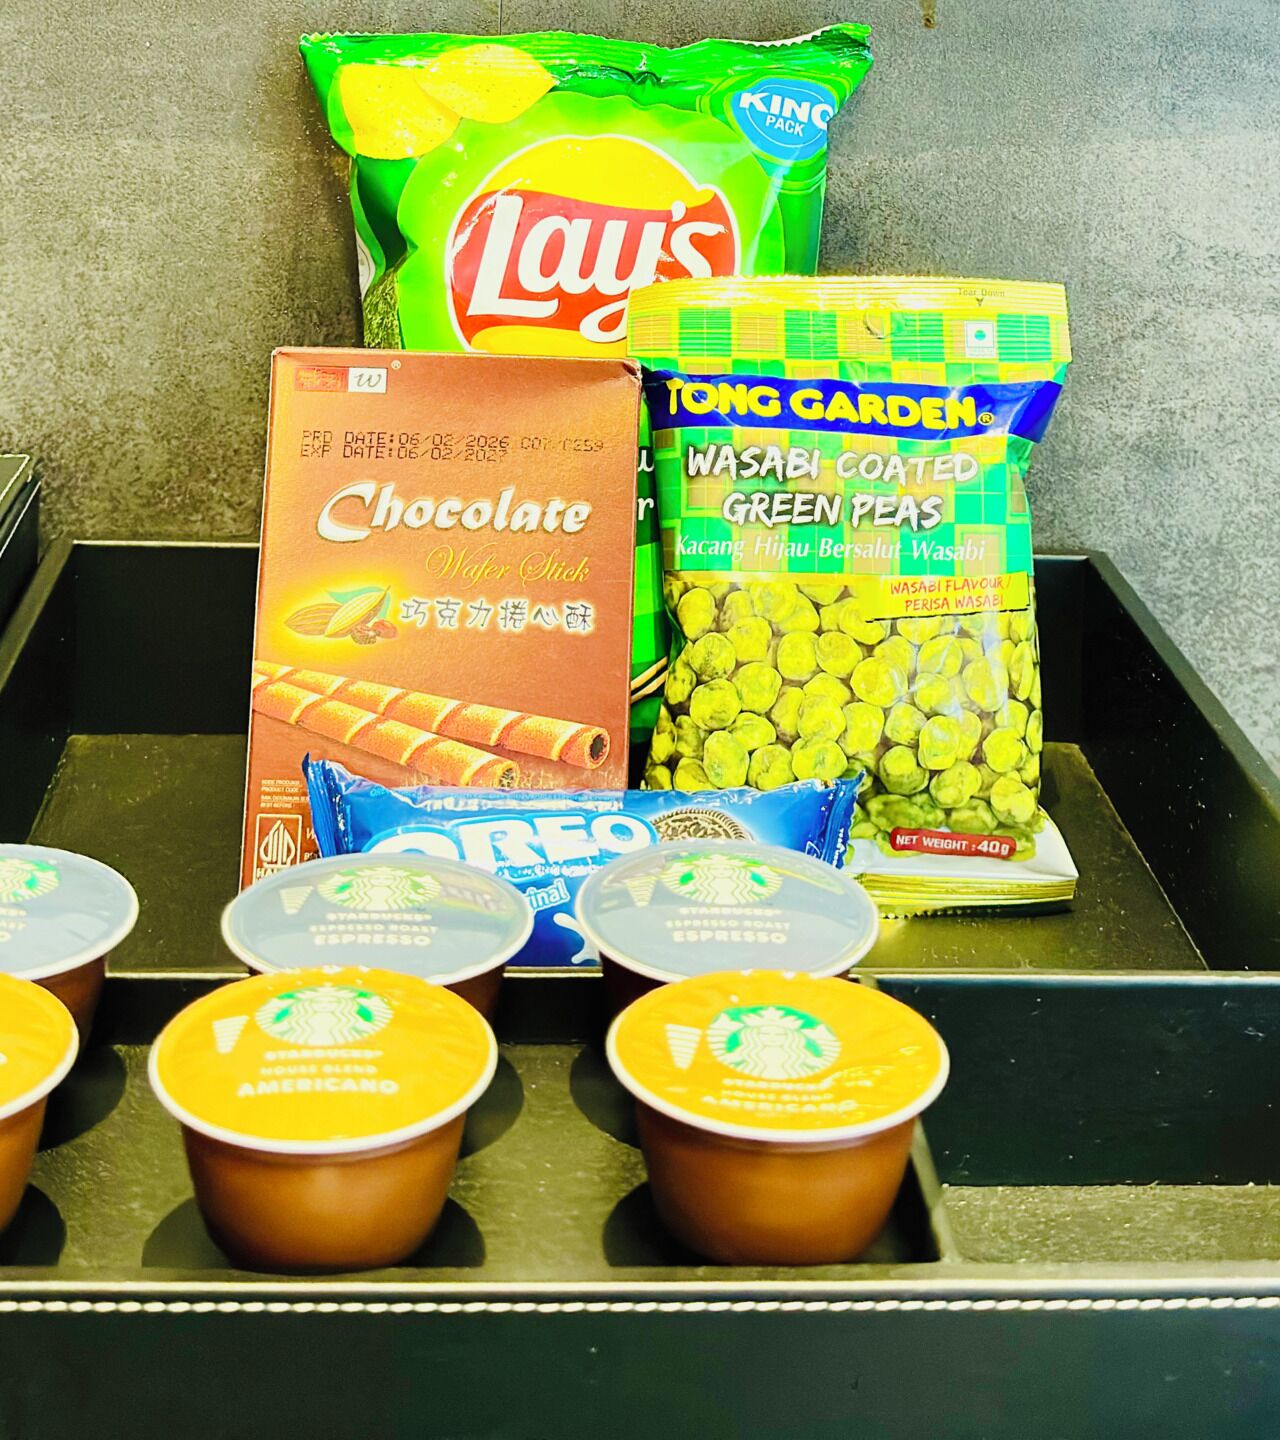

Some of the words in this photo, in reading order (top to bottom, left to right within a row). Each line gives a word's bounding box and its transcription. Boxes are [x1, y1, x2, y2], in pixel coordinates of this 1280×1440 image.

[765, 115, 805, 137] PACK
[466, 194, 729, 343] Lay's
[959, 288, 977, 297] Tear
[981, 288, 1005, 297] Down
[666, 379, 782, 417] TONG
[789, 389, 977, 431] GARDEN
[302, 430, 332, 444] PRD
[301, 444, 332, 458] EXP
[687, 444, 820, 482] WASABI
[836, 452, 979, 486] COATED
[317, 481, 592, 543] Chocolate
[722, 491, 841, 528] GREEN
[851, 493, 944, 532] PEAS
[675, 534, 744, 561] Kacang
[753, 535, 809, 560] Hijau
[819, 536, 902, 560] Bersalut
[912, 538, 985, 561] Wasabi
[426, 542, 510, 590] Wafer
[520, 548, 591, 591] Stick
[890, 580, 941, 595] WASABI
[945, 576, 1004, 592] FLAVOUR
[905, 597, 950, 611] PERISA
[955, 594, 1004, 609] WASABI
[896, 835, 918, 845] NET
[922, 836, 968, 851] WEIGHT
[326, 913, 428, 923] STARBUCKS
[666, 919, 739, 928] ESPRESSO
[744, 921, 790, 930] ROAST
[309, 924, 384, 933] ESPRESSO
[389, 925, 438, 934] ROAST
[673, 930, 787, 944] ESPRESSO
[314, 934, 431, 946] ESPRESSO
[260, 1064, 317, 1076] HOUSE
[322, 1064, 378, 1075] BLEND
[237, 1077, 400, 1097] AMERICANO
